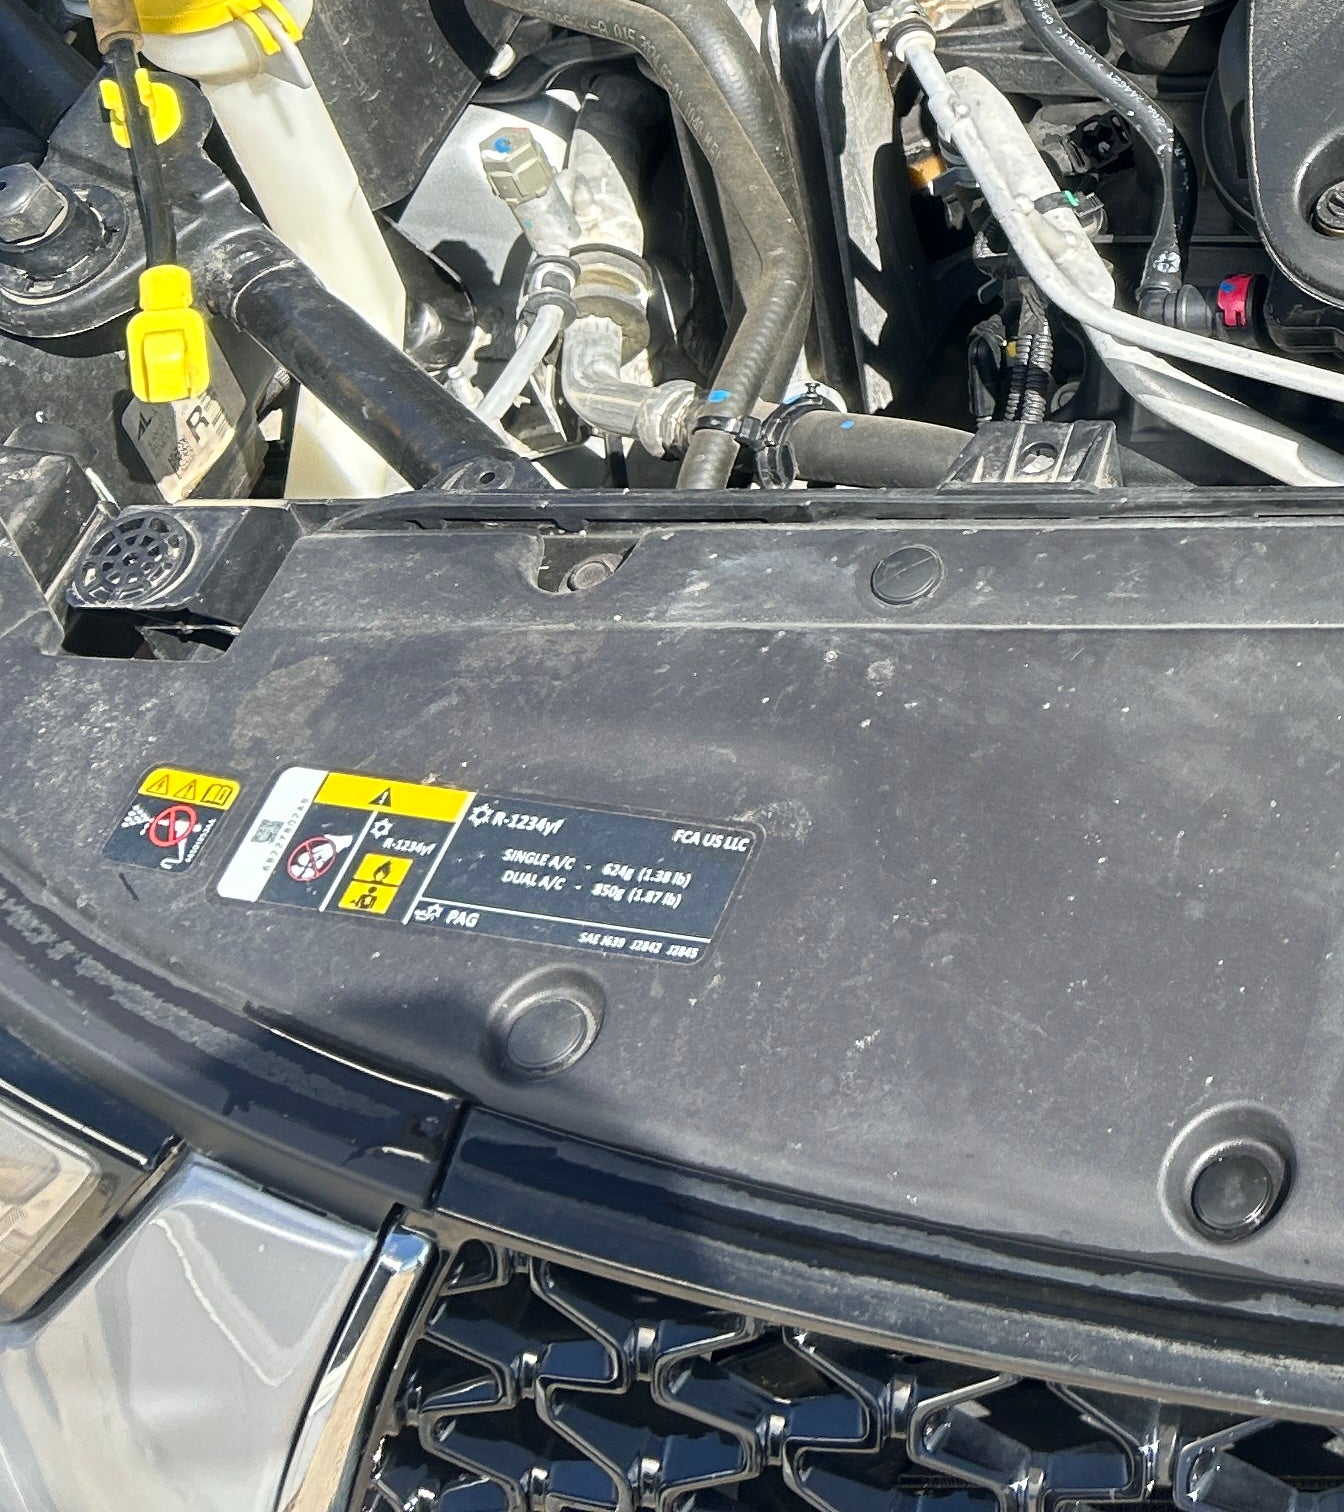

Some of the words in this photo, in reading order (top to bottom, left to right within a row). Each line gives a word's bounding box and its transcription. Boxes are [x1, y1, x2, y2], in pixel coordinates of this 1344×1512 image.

[492, 810, 566, 836] R-1234yf
[382, 837, 438, 857] R-1234yf
[672, 829, 701, 846] FCA
[701, 832, 724, 849] US
[723, 835, 750, 852] LLC
[502, 848, 549, 867] SINGLE
[548, 855, 576, 872] A/C
[601, 861, 636, 882] 624g
[637, 866, 672, 885] (1.38
[671, 871, 692, 889] lb)
[501, 870, 537, 887] DUAL
[537, 874, 567, 891] A/C
[591, 882, 626, 902] 850g
[627, 887, 661, 905] (1.87
[661, 891, 683, 909] lb)
[445, 909, 480, 928] PAG
[577, 931, 601, 945] SAE
